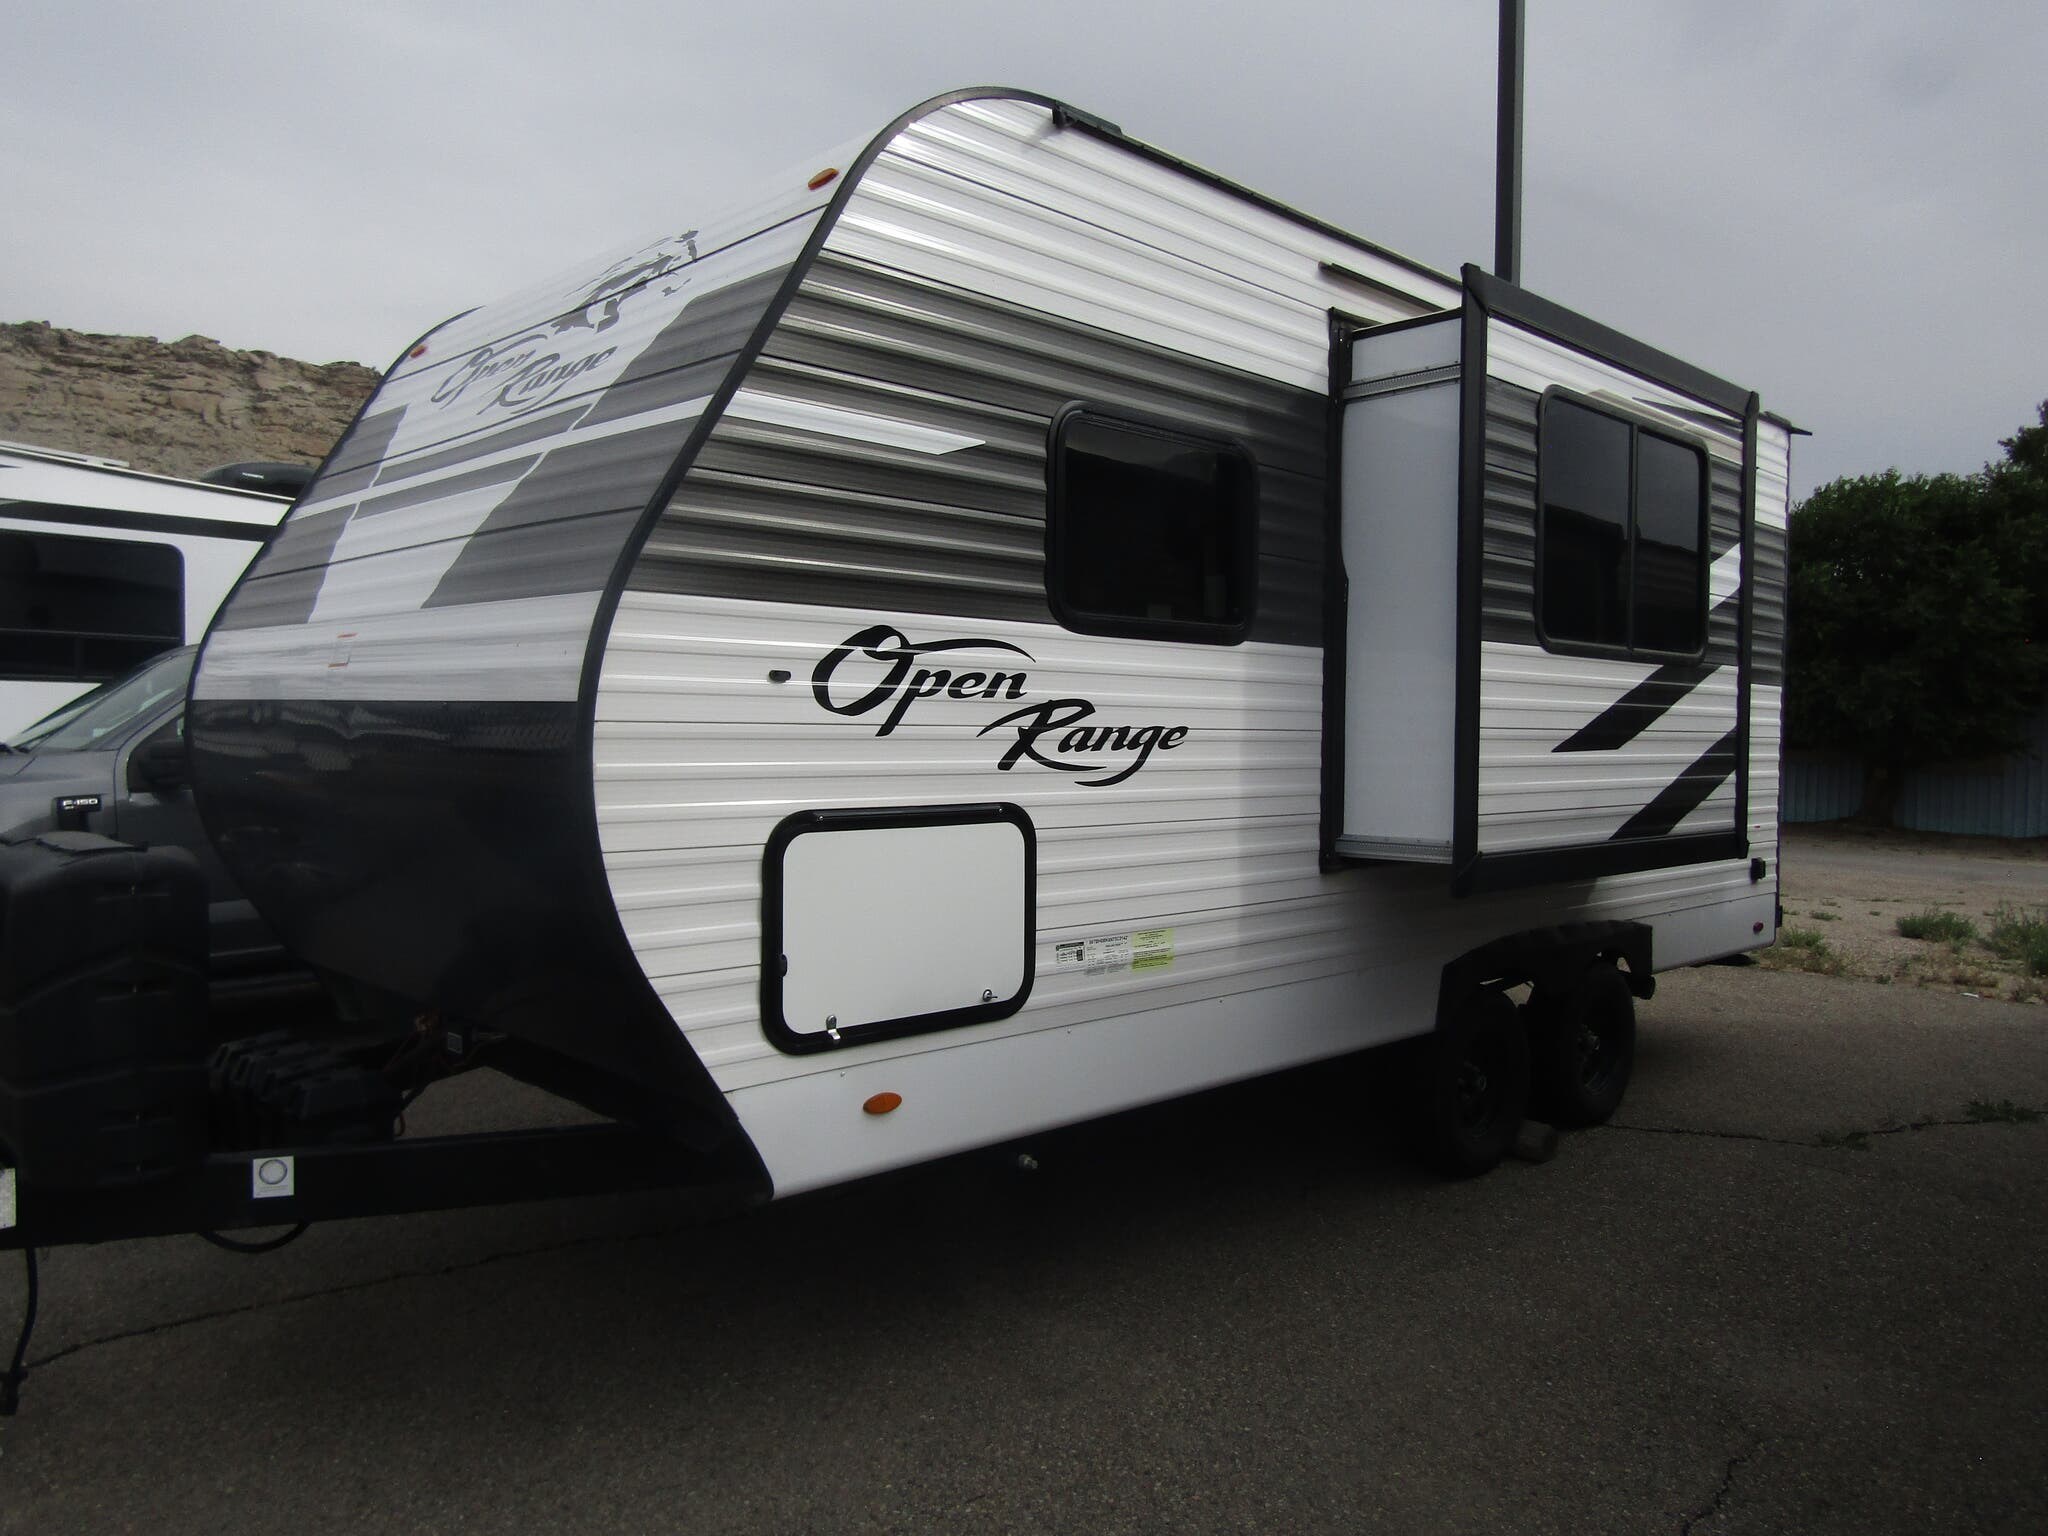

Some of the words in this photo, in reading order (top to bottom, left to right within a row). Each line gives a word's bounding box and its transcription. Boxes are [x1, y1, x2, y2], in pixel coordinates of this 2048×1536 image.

[431, 334, 548, 410] Open
[477, 346, 618, 415] Range
[811, 624, 1036, 737] Open
[976, 698, 1189, 787] Range
